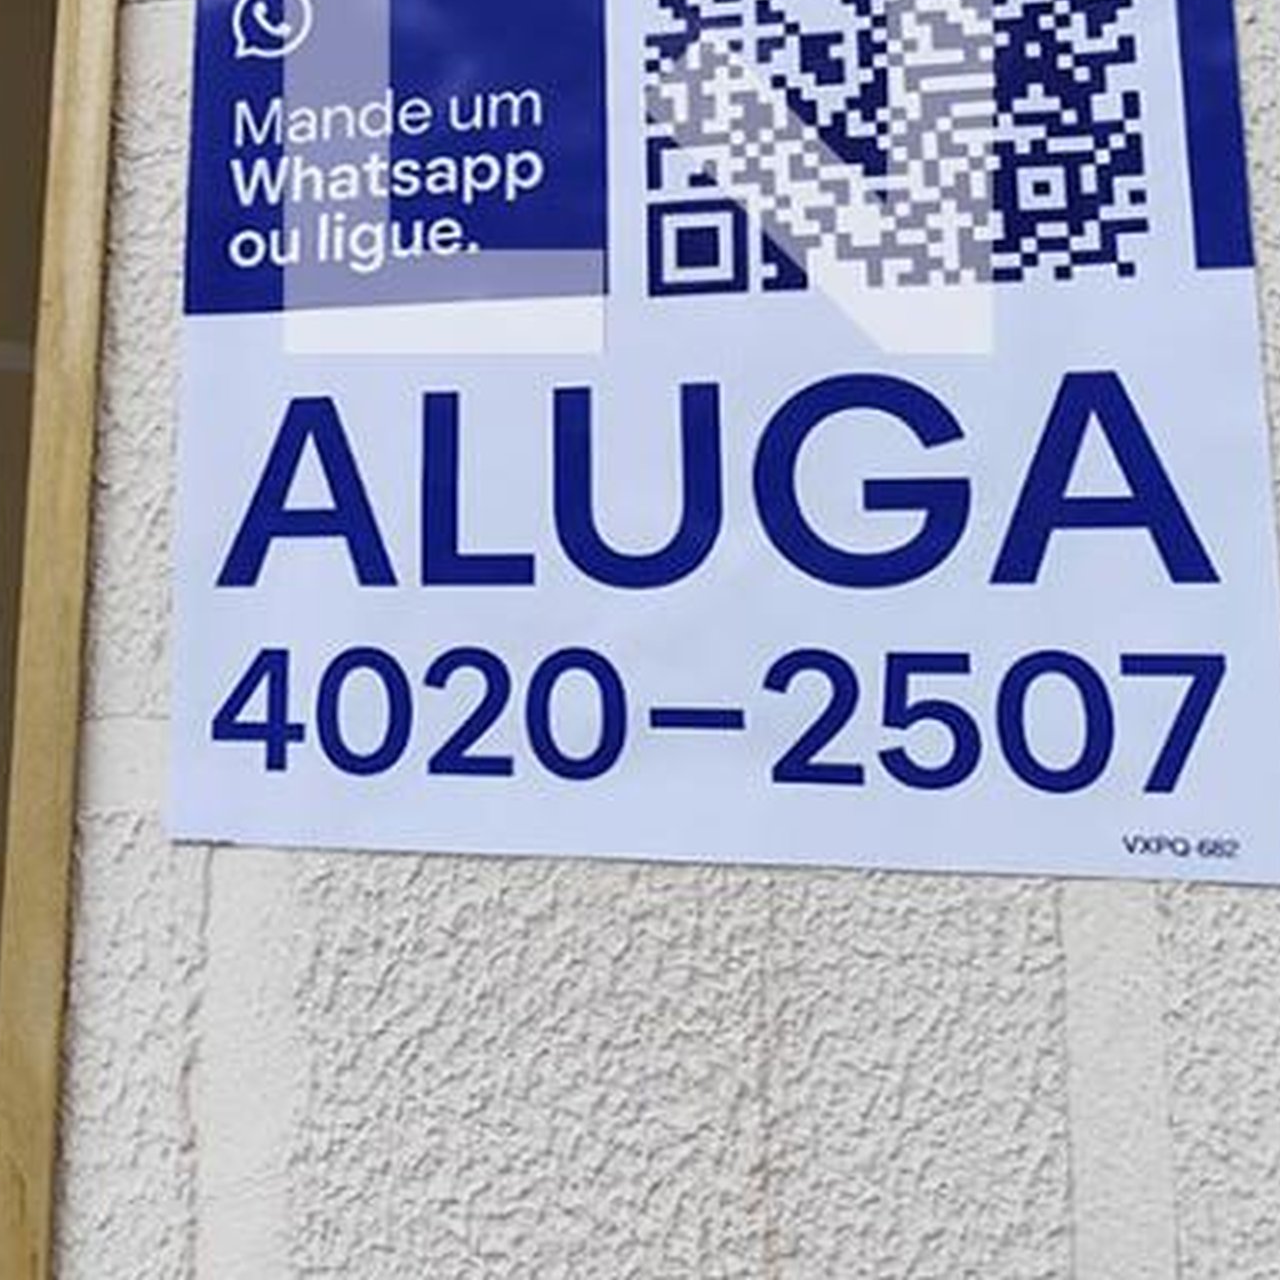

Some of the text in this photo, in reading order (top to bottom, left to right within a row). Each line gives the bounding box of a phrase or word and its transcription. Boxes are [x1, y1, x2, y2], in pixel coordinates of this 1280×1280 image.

[232, 87, 542, 148] Mande um
[229, 148, 544, 207] Whatsapp
[228, 212, 480, 273] ou ligue.
[214, 368, 1223, 591] ALUGA
[210, 645, 1228, 796] 4020-2507
